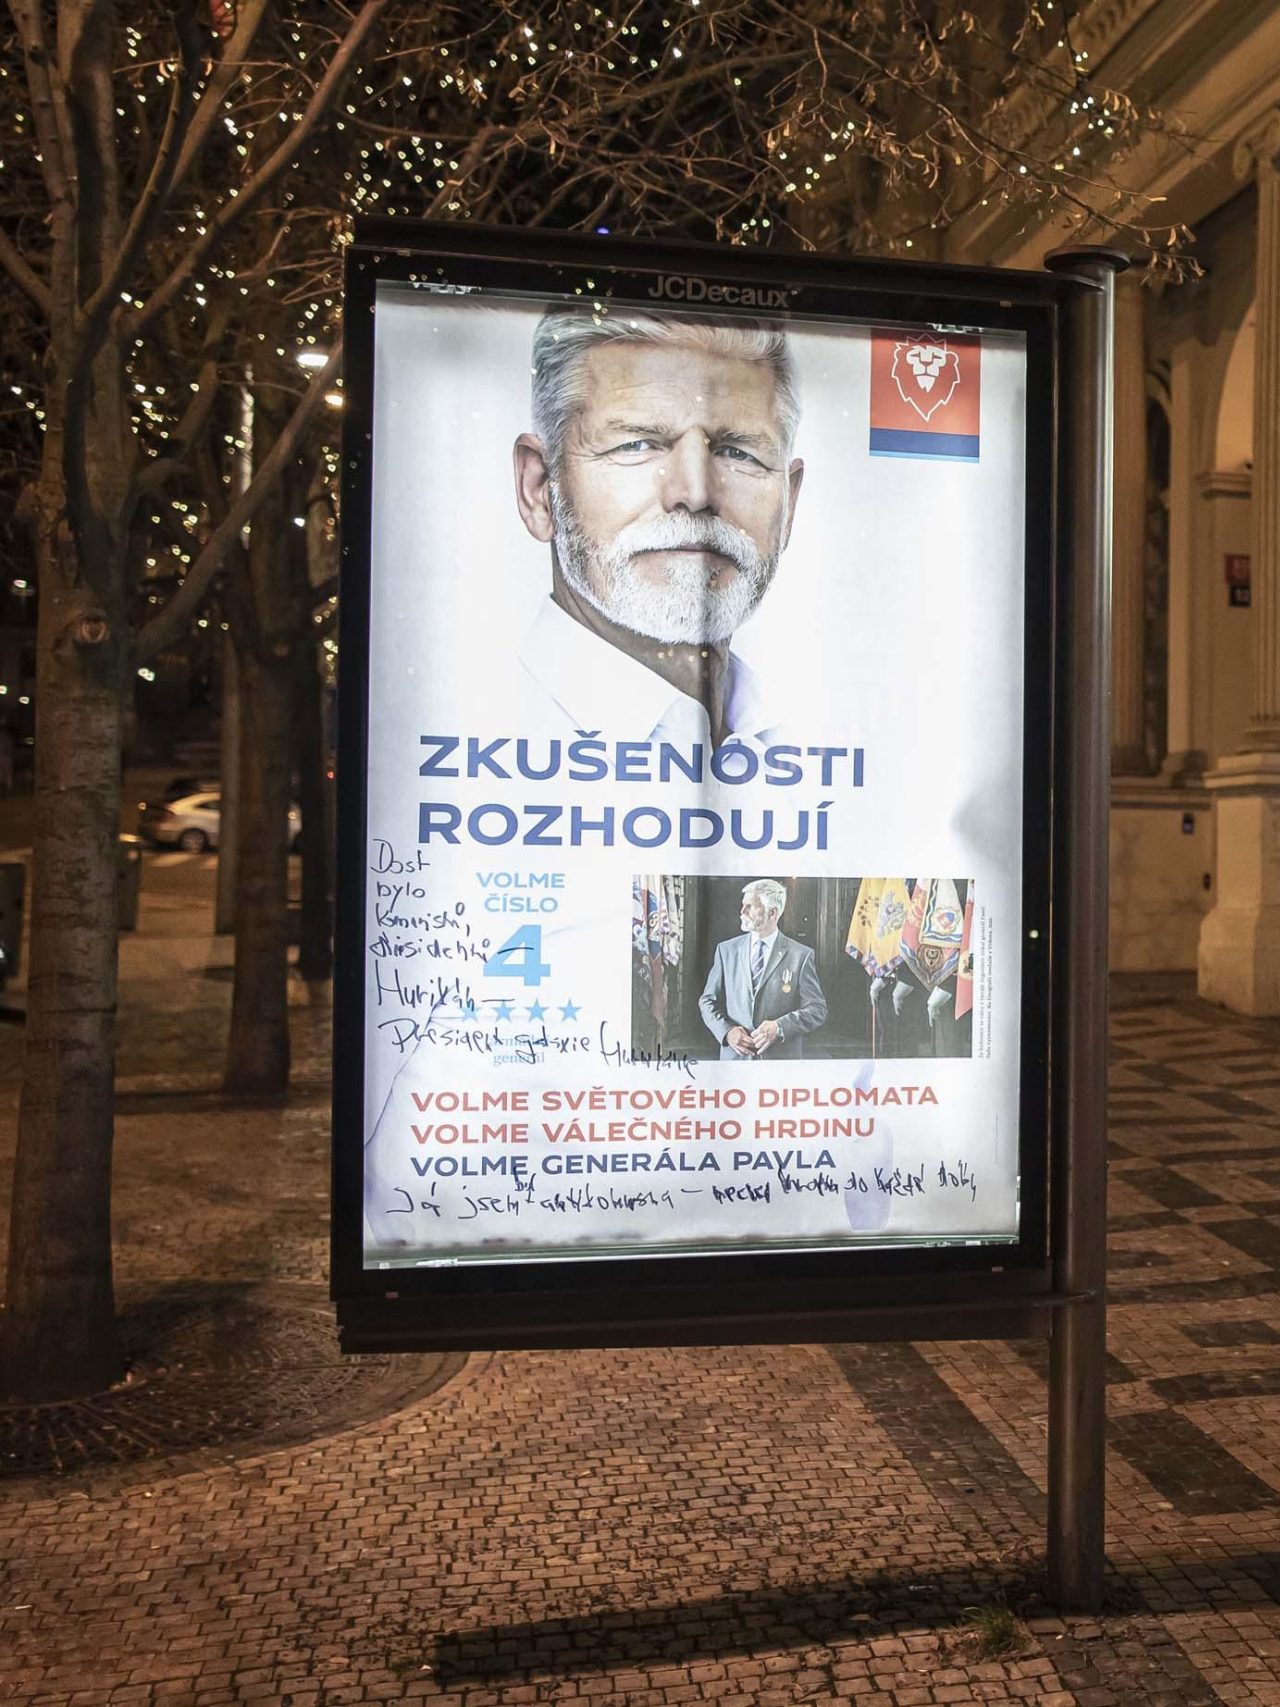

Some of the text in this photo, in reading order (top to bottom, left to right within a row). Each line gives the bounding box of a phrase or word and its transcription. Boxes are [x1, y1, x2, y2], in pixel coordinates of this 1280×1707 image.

[647, 274, 790, 308] JCDecaux
[418, 729, 865, 788] ZKUŠENOSTI
[417, 800, 835, 851] ROZHODUJÍ
[370, 838, 431, 875] Dost
[475, 872, 566, 888] VOLME
[376, 881, 427, 913] bylo
[483, 893, 559, 913] ČÍSLO
[483, 924, 551, 987] 4
[410, 1084, 939, 1113] VOLME SVĚTOVÉHO DIPLOMATA
[410, 1116, 876, 1145] VOLME VÁLEČNÉHO HRDINU
[410, 1147, 837, 1178] VOLME GENERÁLA PAVLA
